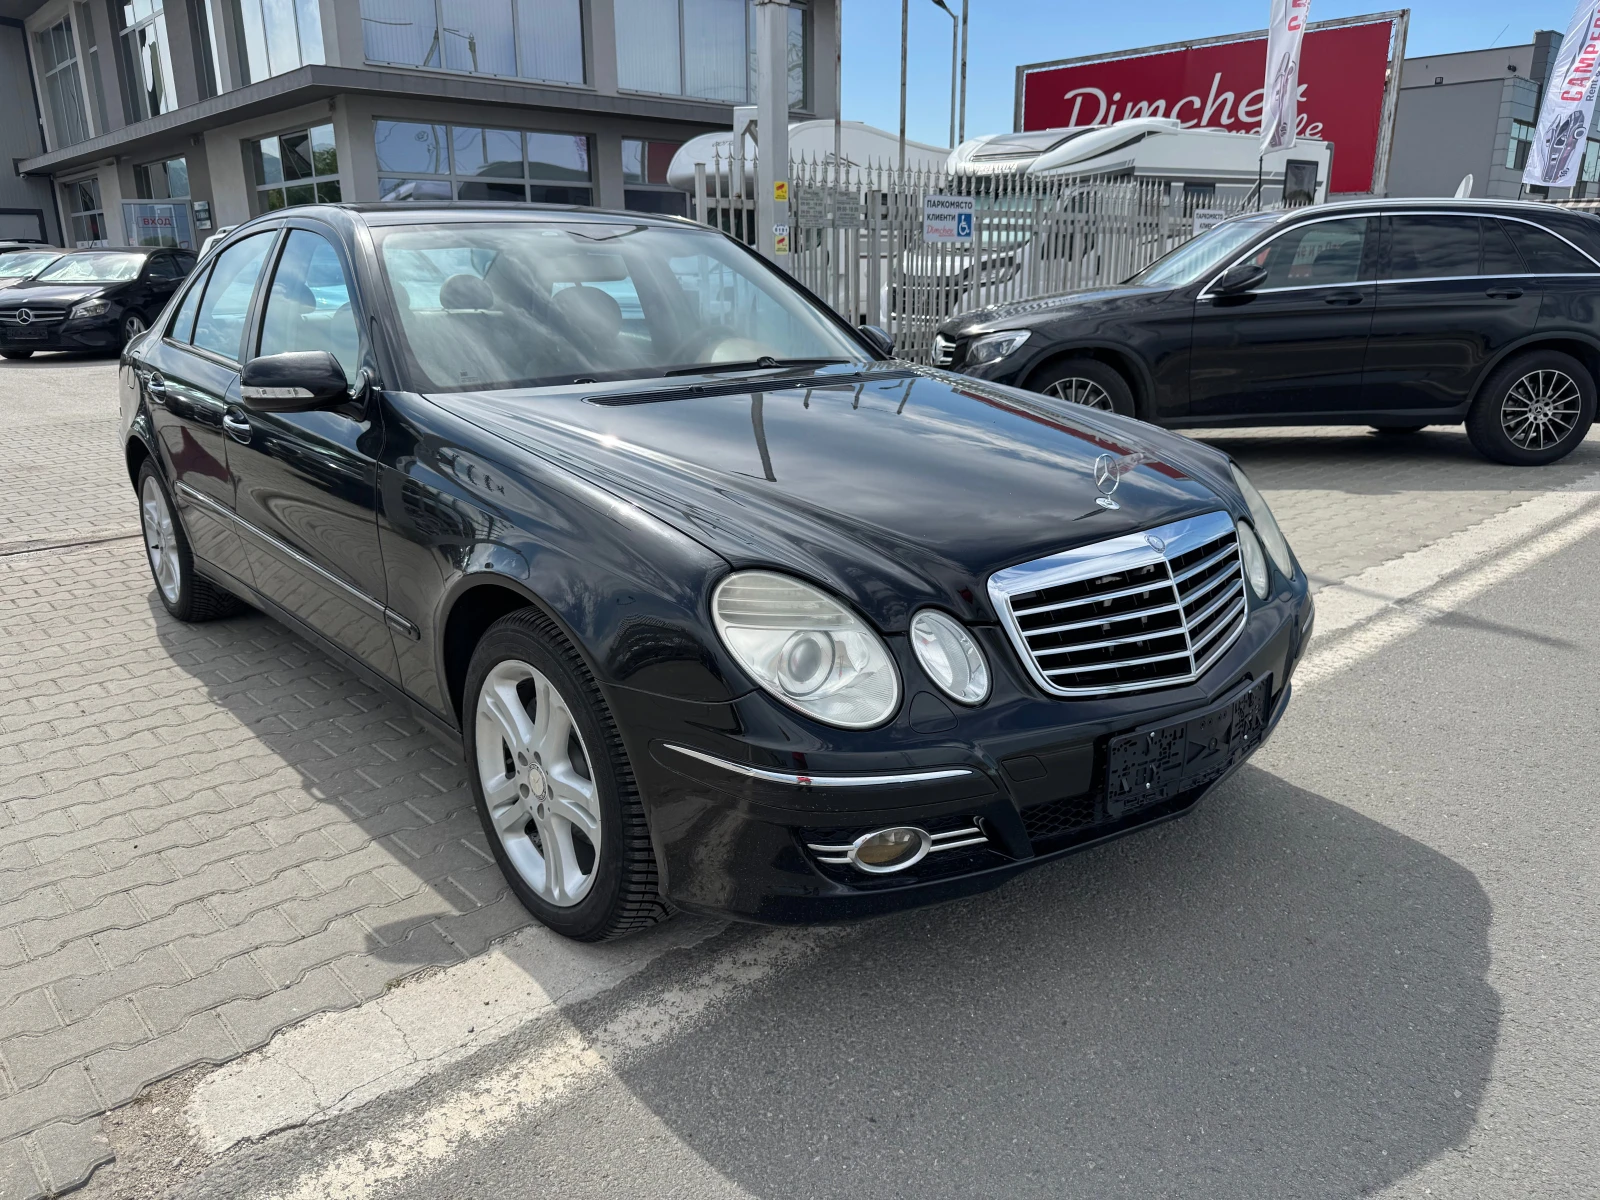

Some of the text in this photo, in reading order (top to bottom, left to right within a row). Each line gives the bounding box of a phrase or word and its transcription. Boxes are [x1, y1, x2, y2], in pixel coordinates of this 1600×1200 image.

[1585, 79, 1599, 102] Rent
[1064, 72, 1308, 129] Dimche
[926, 199, 973, 210] ПАРКОМЯСТО
[142, 217, 172, 227] ВХОД
[926, 213, 956, 222] КЛИЕНТИ
